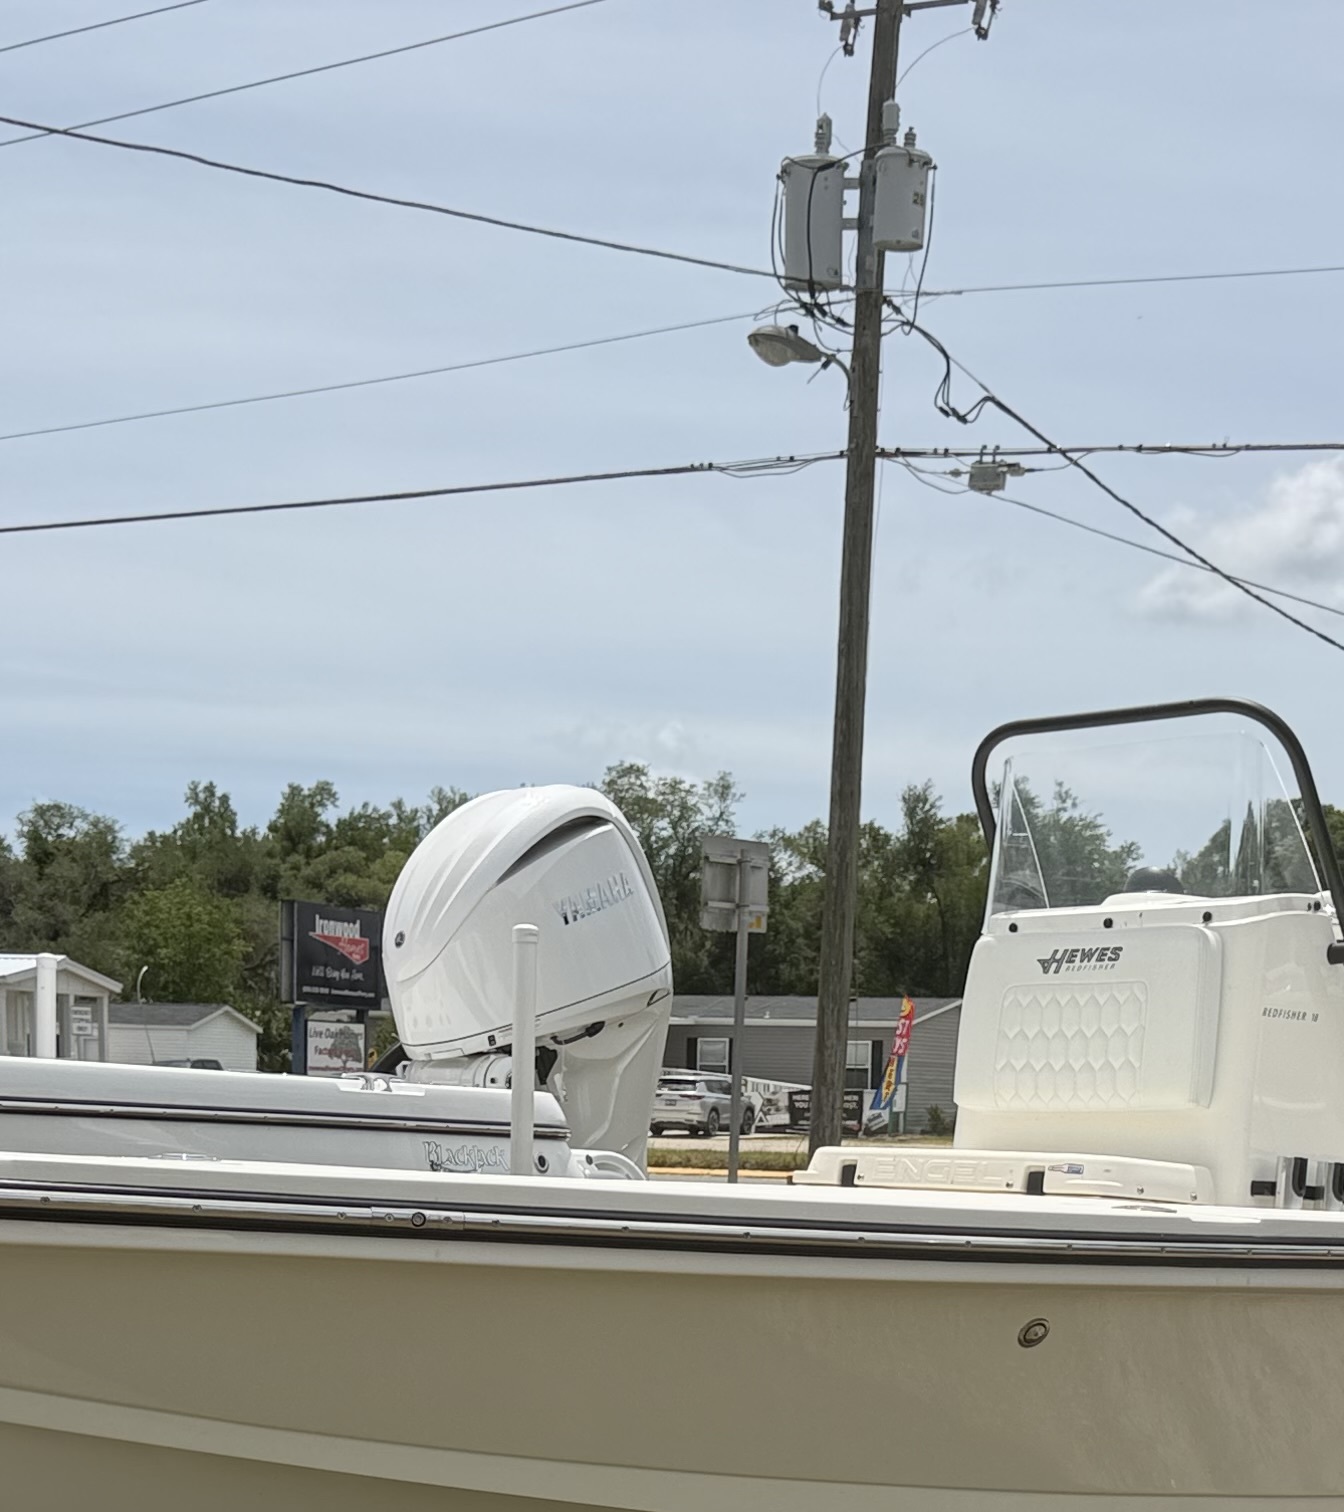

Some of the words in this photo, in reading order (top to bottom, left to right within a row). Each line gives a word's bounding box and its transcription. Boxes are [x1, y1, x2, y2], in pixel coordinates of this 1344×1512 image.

[552, 872, 634, 925] YAMAHA
[1036, 945, 1124, 975] HEWES
[1064, 963, 1116, 973] REDFISHER
[1261, 1007, 1308, 1022] REDFISHER
[871, 1156, 1003, 1184] ENGEL
